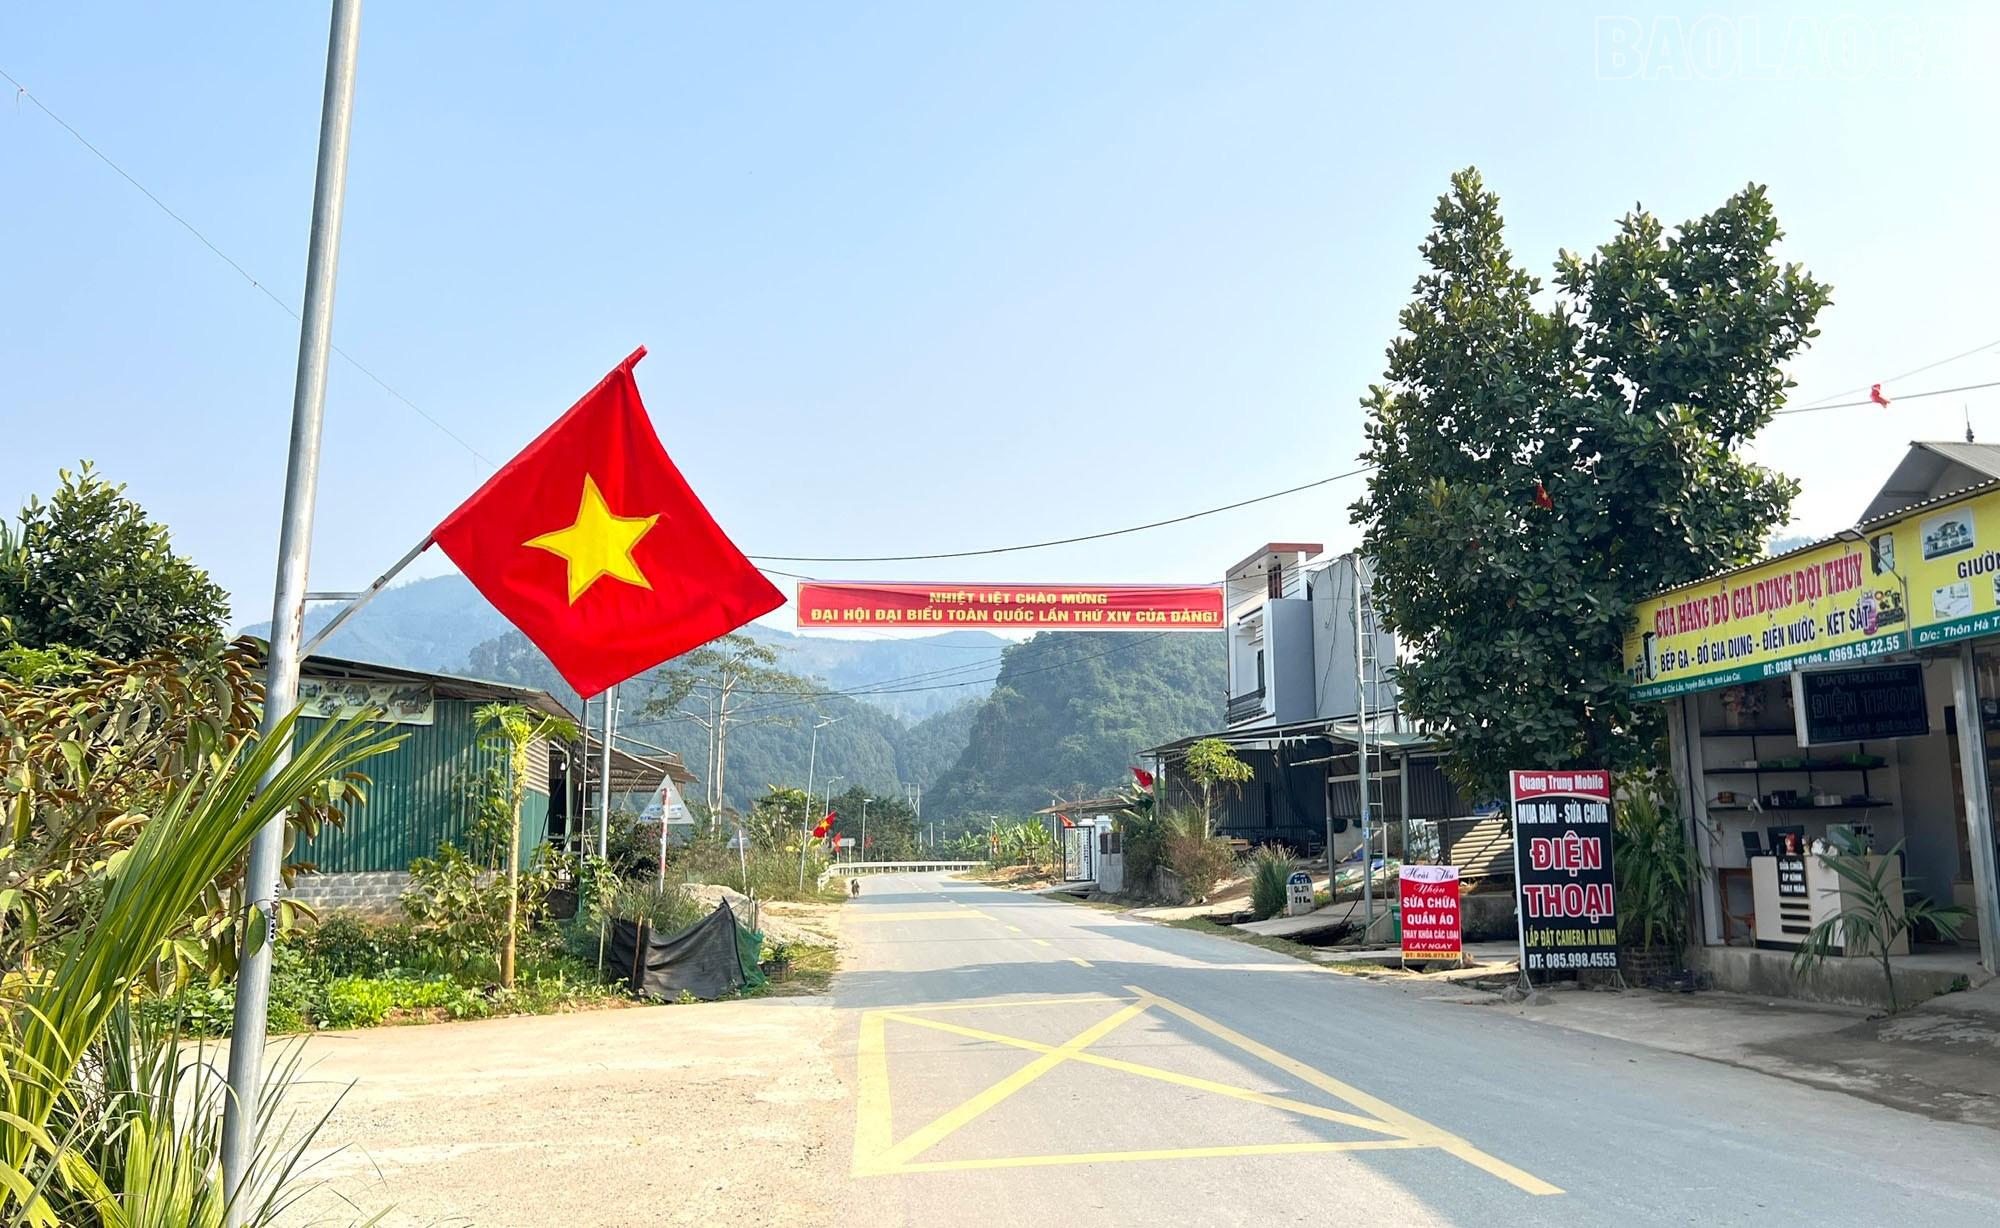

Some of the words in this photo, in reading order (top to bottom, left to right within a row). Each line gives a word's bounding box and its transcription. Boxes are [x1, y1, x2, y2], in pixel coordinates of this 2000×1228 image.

[929, 592, 975, 605] NHIỆT
[979, 592, 1011, 606] LIỆT
[1015, 591, 1057, 604] CHÀO
[1061, 592, 1107, 604] MỪNG
[1655, 600, 1677, 639] CỬA
[1678, 595, 1710, 633] HÀNG
[1711, 581, 1730, 625] ĐỒ
[1732, 585, 1755, 620] GIA
[1757, 573, 1792, 619] DỤNG
[1824, 546, 1863, 595] THỦY
[811, 609, 839, 623] ĐẠI
[844, 607, 871, 623] HỘI
[875, 609, 901, 623] ĐẠI
[907, 605, 942, 621] BIỂU
[947, 608, 988, 621] TOÀN
[993, 606, 1034, 622] QUỐC
[1039, 607, 1069, 621] LẦN
[1073, 609, 1103, 621] THỨ
[1106, 611, 1131, 622] XIV
[1136, 608, 1166, 622] CỦA
[1170, 608, 1218, 623] ĐẢNG!
[1660, 646, 1676, 672] BẾP
[1678, 649, 1689, 669] GA
[1697, 637, 1709, 665] ĐỒ
[1711, 641, 1726, 662] GIA
[1728, 634, 1753, 662] DỤNG
[1762, 624, 1785, 654] ĐIỆN
[1787, 616, 1815, 645] NƯỚC
[1826, 607, 1845, 637] KẾT
[1849, 599, 1869, 630] SẮT
[1920, 630, 1940, 642] Đ/c:
[1944, 624, 1970, 637] Thôn
[1974, 619, 1989, 631] Hà
[1830, 636, 1899, 661] 0969.58.22.55
[1811, 687, 1857, 722] ĐIỆN
[1519, 774, 1546, 791] Quang
[1547, 775, 1573, 791] Trung
[1574, 774, 1604, 790] Mobile
[1518, 804, 1538, 824] MUA
[1539, 801, 1557, 823] BÁN
[1564, 799, 1583, 823] SỬA
[1583, 801, 1608, 823] CHỮA
[1529, 830, 1602, 877] ĐIỆN
[1414, 883, 1446, 895] Nhận
[1403, 894, 1424, 908] SỬA
[1427, 895, 1456, 909] CHỮA
[1522, 883, 1614, 924] THOẠI
[1407, 911, 1436, 926] QUẦN
[1439, 912, 1454, 925] ÁO
[1403, 930, 1417, 939] THAY
[1526, 926, 1539, 947] LẮP
[1541, 928, 1554, 950] ĐẶT
[1556, 929, 1586, 946] CAMERA
[1587, 929, 1597, 945] AN
[1598, 929, 1617, 945] NINH
[1546, 952, 1616, 968] 085.998.4555
